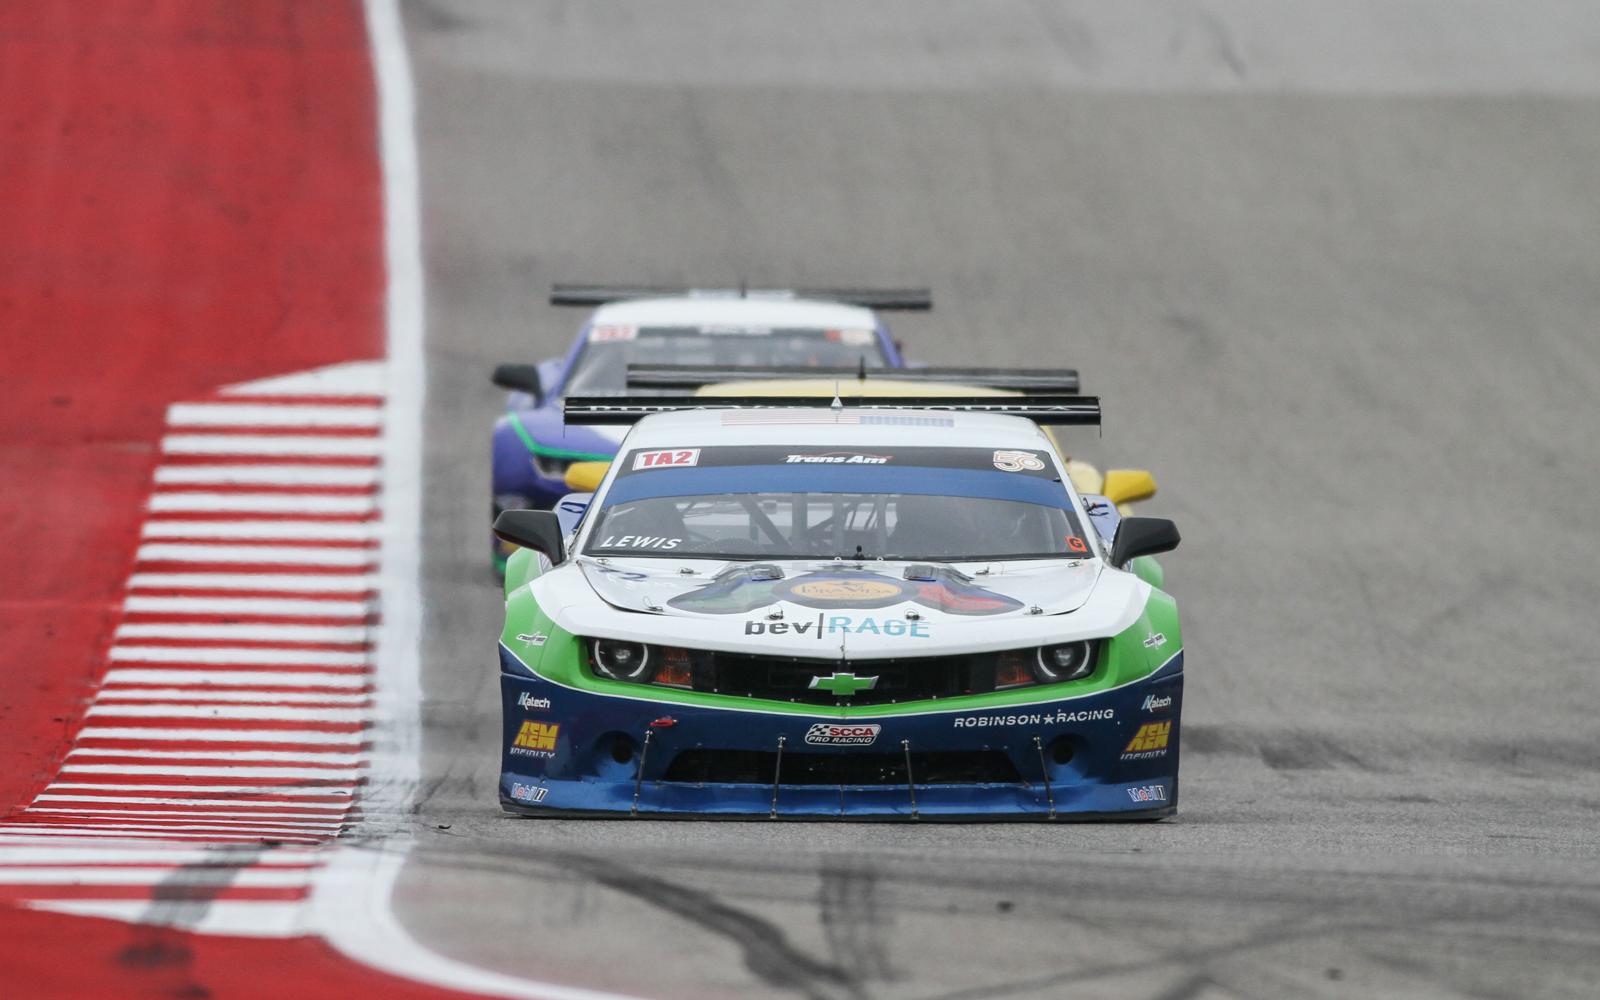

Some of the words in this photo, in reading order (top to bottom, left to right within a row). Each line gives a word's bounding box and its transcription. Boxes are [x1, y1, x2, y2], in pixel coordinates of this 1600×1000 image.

[642, 451, 693, 467] TA2
[786, 454, 847, 464] Trans
[845, 455, 888, 464] Am
[993, 450, 1046, 472] 50
[600, 535, 683, 549] LEWIS
[517, 692, 551, 710] Katech
[953, 714, 1041, 728] ROBINSON
[1056, 709, 1115, 723] RACING
[513, 720, 559, 750] AEM
[829, 727, 875, 737] SCCA
[831, 736, 874, 744] RACING
[1125, 720, 1172, 752] AEM
